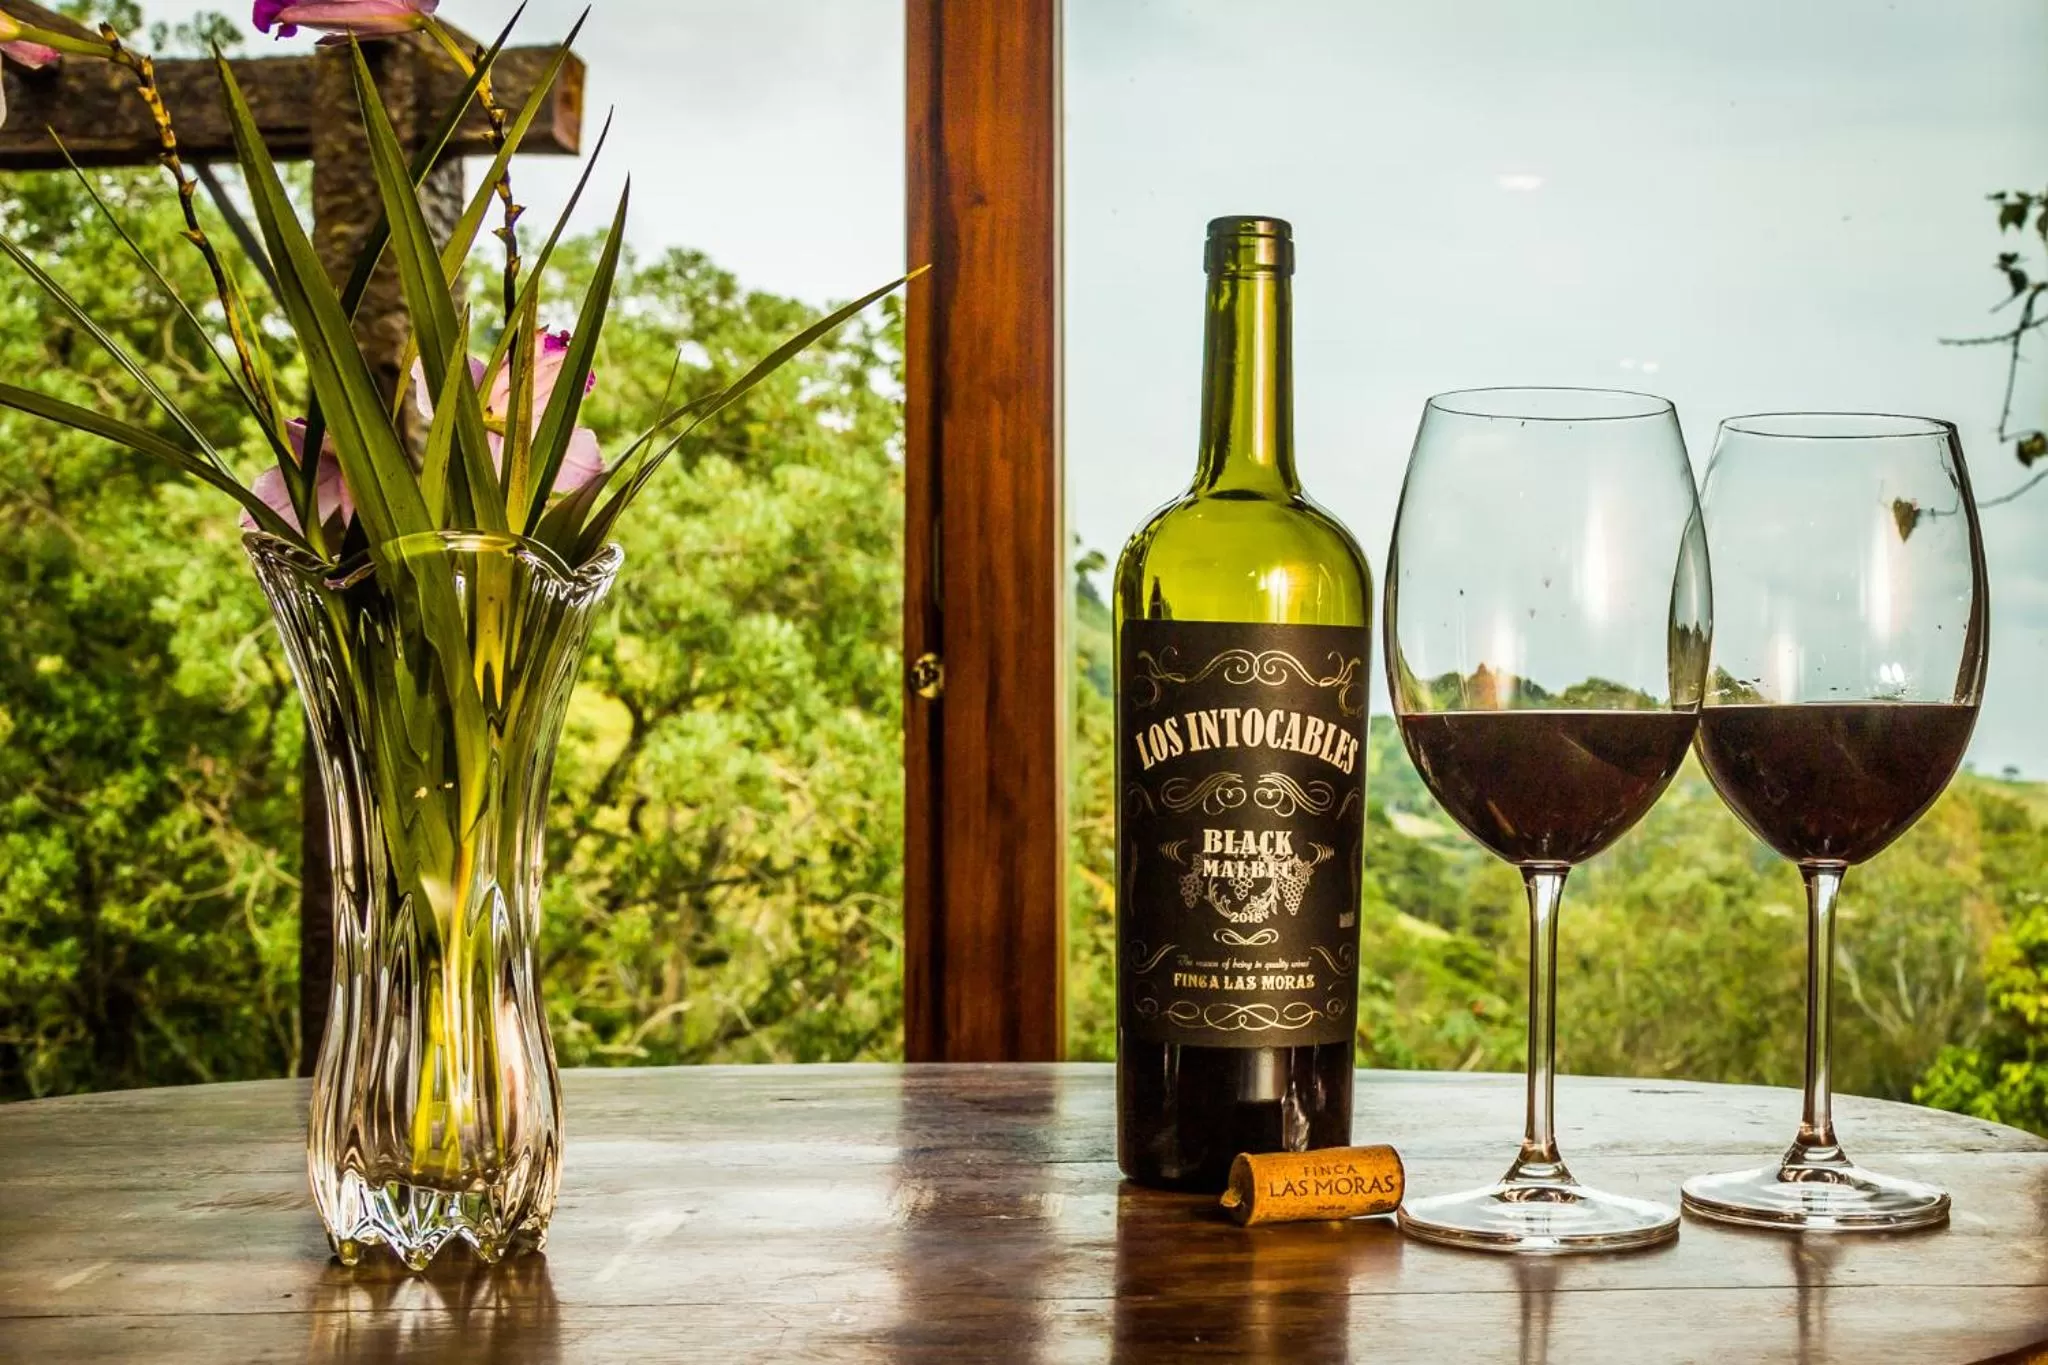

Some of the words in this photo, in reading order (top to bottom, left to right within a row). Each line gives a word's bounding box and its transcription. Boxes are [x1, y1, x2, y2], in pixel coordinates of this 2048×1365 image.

[1135, 716, 1184, 771] LOS
[1184, 708, 1359, 775] INTOCABLES
[1203, 829, 1293, 855] BLACK
[1203, 860, 1291, 878] MALBEC
[1221, 957, 1231, 970] of
[1232, 957, 1252, 971] being
[1254, 960, 1262, 968] in
[1264, 957, 1289, 971] quality
[1223, 975, 1257, 990] LAS
[1261, 974, 1316, 990] MORAS
[1303, 1163, 1361, 1177] FINCA
[1269, 1178, 1309, 1198] LAS
[1313, 1173, 1396, 1198] MORAS
